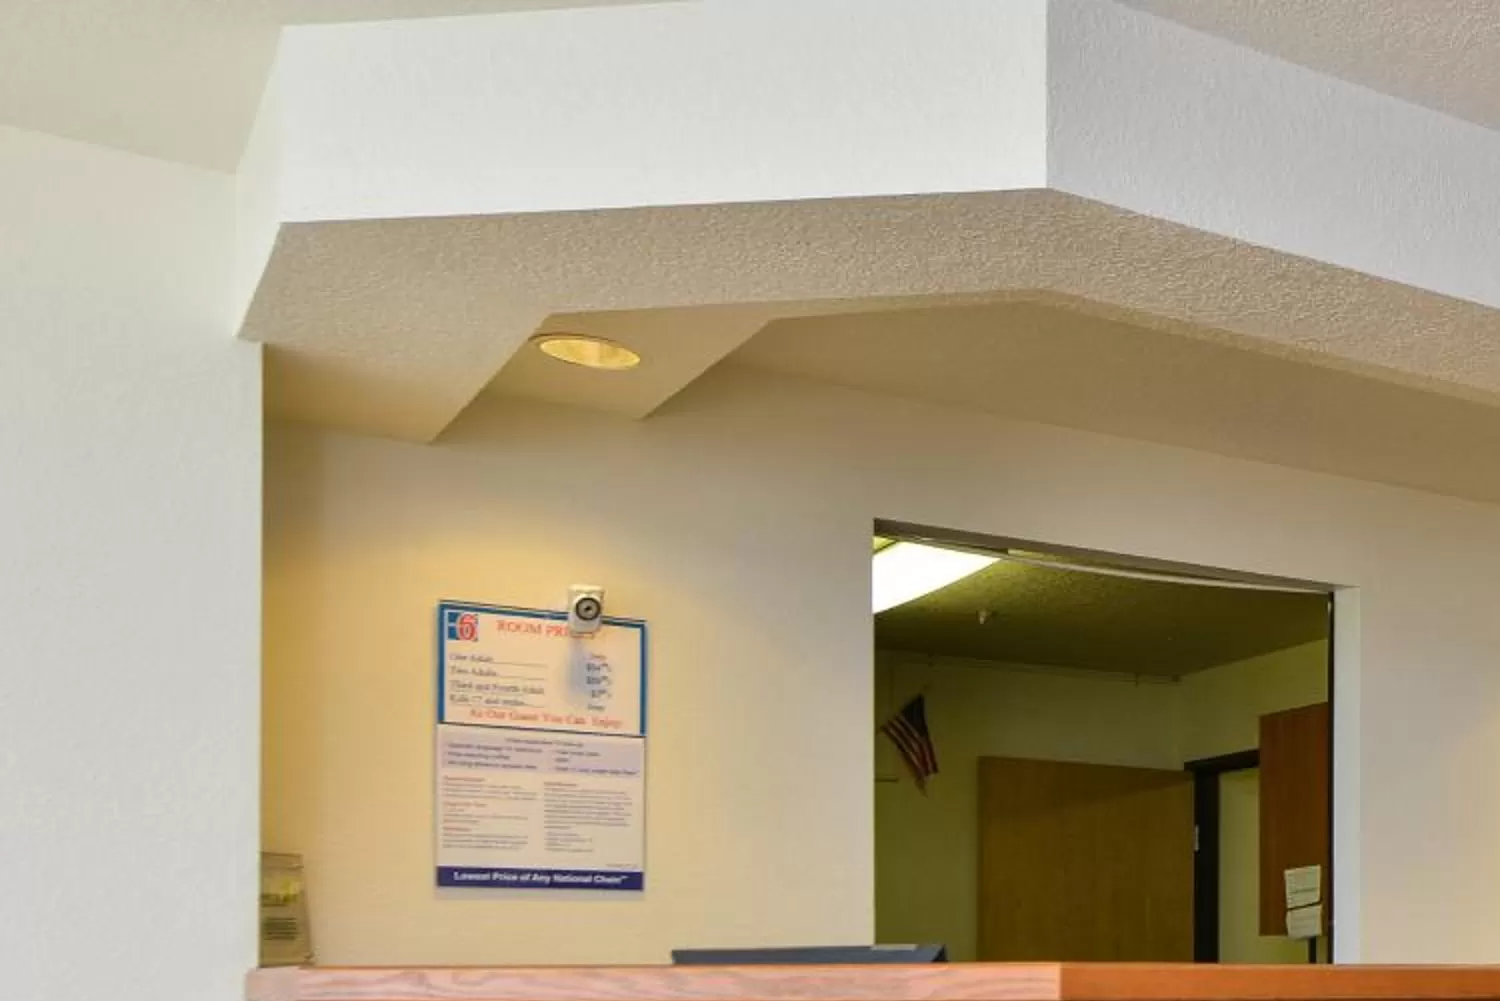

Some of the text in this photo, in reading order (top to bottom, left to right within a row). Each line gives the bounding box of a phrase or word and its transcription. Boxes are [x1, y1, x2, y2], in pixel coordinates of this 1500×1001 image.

[496, 620, 542, 634] ROOM
[453, 871, 490, 881] Lowest
[492, 872, 517, 881] Price
[519, 872, 531, 882] of
[532, 873, 550, 884] Any
[553, 873, 593, 883] National
